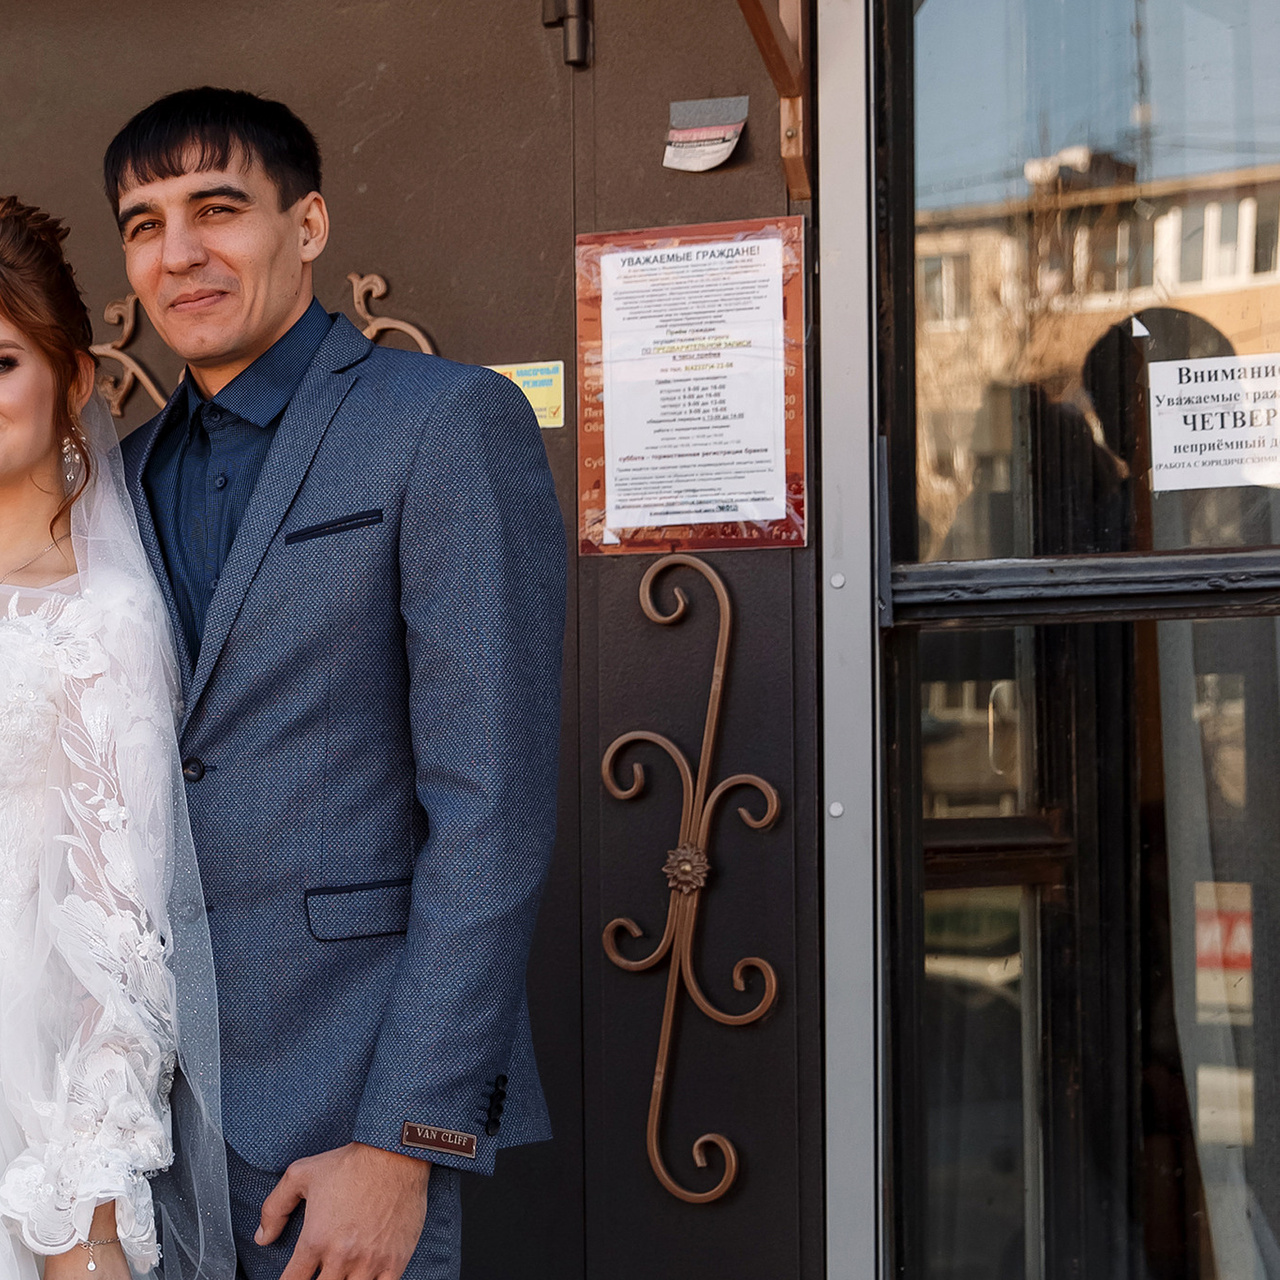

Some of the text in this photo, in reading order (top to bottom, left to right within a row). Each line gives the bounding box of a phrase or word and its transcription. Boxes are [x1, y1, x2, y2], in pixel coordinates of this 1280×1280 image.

[620, 245, 760, 267] УВАЖАЕМЫЕ ГРАЖДАНЕ!
[1155, 390, 1241, 408] Уважаемые
[1183, 408, 1278, 432] ЧЕТВЕР
[1173, 436, 1266, 455] неприёмный
[1155, 462, 1192, 471] (РАБОТА
[416, 1127, 468, 1146] VAN CLIFF
